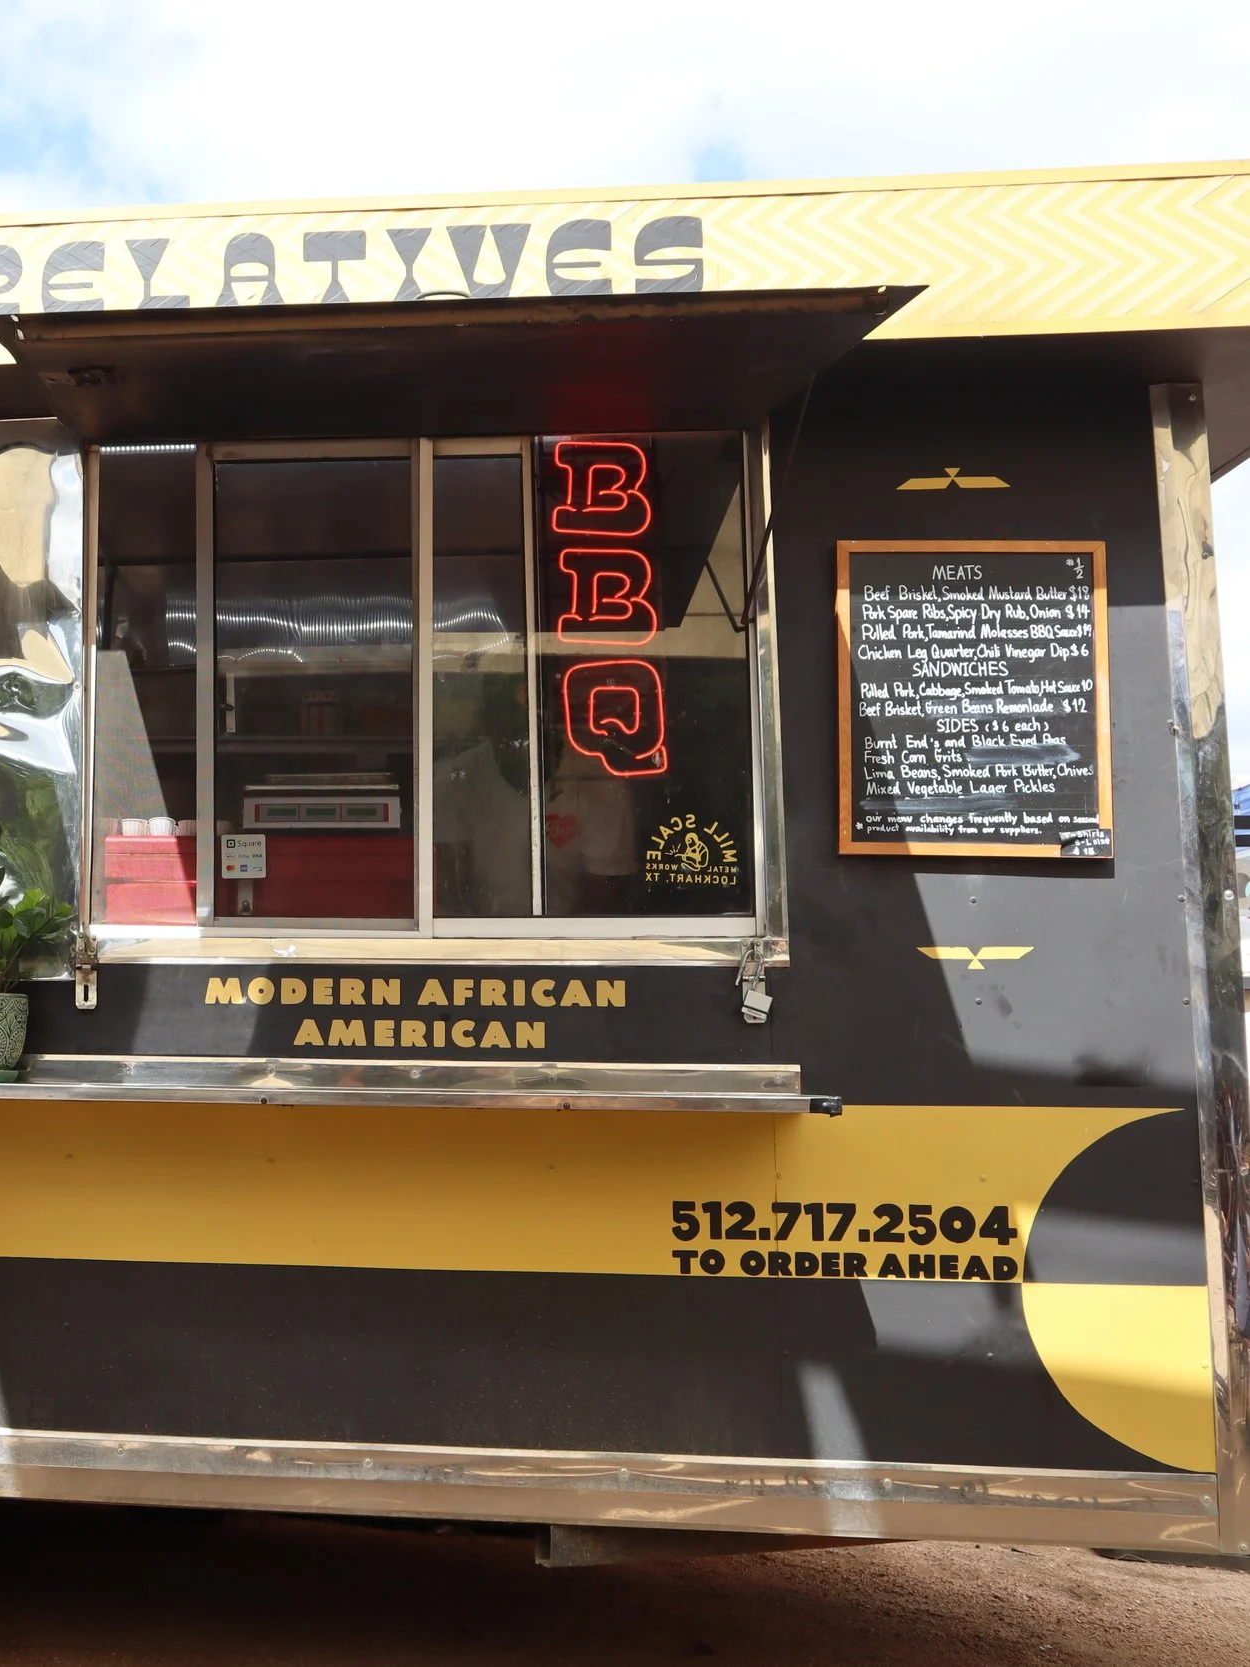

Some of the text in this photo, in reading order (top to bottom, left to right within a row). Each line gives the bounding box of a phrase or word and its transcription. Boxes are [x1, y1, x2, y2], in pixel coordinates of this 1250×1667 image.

[932, 565, 983, 580] MEATS
[864, 586, 891, 601] Beef
[989, 586, 1032, 600] Mustard
[1036, 586, 1068, 600] Butter
[552, 441, 667, 776] BBQ
[862, 604, 887, 620] Pork
[887, 605, 918, 625] Spare
[981, 605, 1001, 624] Dry
[862, 623, 896, 641] Pulled
[980, 622, 1029, 639] Molasses
[1030, 624, 1054, 639] BBQ
[858, 644, 902, 660] Chicken
[908, 645, 928, 664] Leg
[1005, 644, 1046, 663] Vinegar
[1051, 643, 1070, 662] Dip
[912, 661, 1009, 678] SANDWICHES
[861, 682, 889, 699] Pulled
[1057, 681, 1081, 694] Sauce
[859, 701, 881, 717] Beef
[962, 700, 993, 714] Beans
[1063, 698, 1088, 713] $12
[937, 719, 979, 733] SIDES
[865, 736, 898, 750] Burnt
[944, 736, 966, 748] and
[971, 735, 1006, 747] Black
[865, 753, 895, 765] Fresh
[864, 767, 895, 780] Lima
[943, 765, 991, 779] Smoked
[995, 764, 1018, 777] Pork
[866, 781, 901, 796] Mixed
[907, 780, 963, 797] Vegetable
[1014, 779, 1055, 793] Pickles
[866, 813, 883, 823] our
[920, 813, 964, 825] changes
[968, 811, 1018, 827] frequently
[1023, 812, 1053, 824] based
[1058, 815, 1071, 824] on
[867, 824, 900, 834] product
[905, 823, 954, 836] availability
[958, 824, 978, 834] from
[982, 826, 996, 834] our
[238, 840, 262, 848] Square
[205, 976, 626, 1008] MODERN AFRICAN
[293, 1018, 546, 1049] AMERICAN
[671, 1200, 1018, 1246] 512.717.2504
[672, 1249, 1018, 1281] TO ORDER AHEAD
